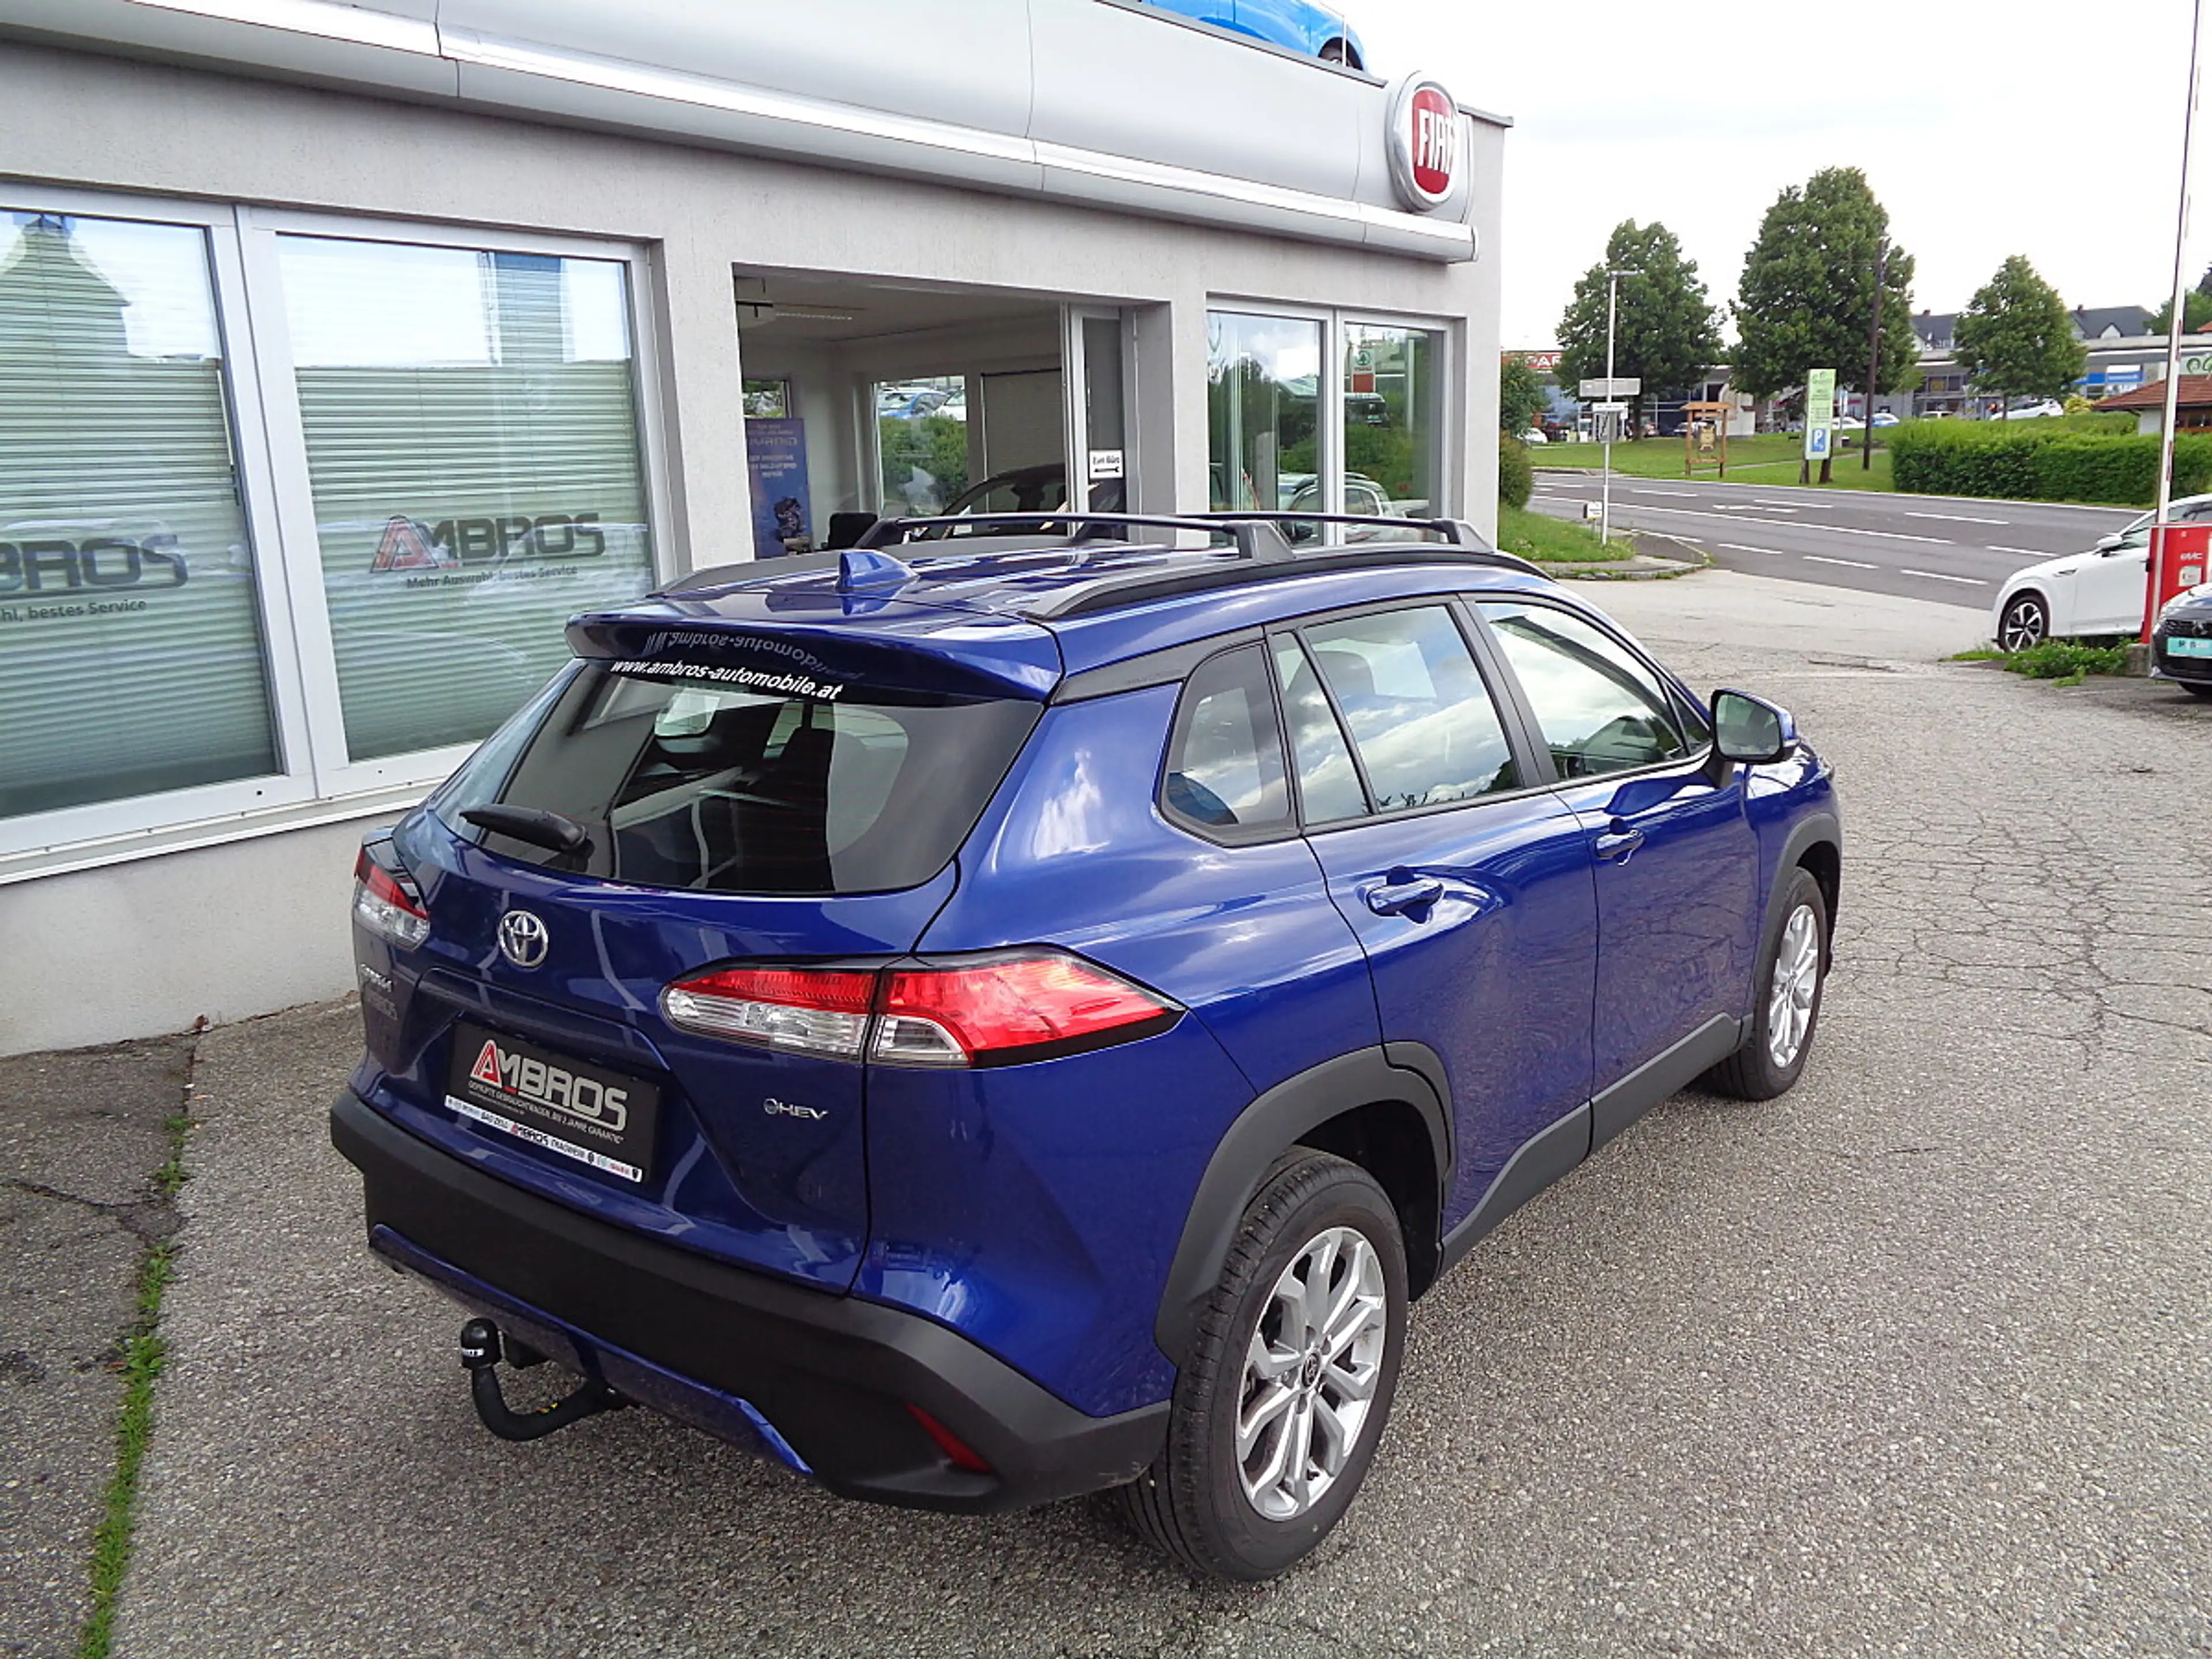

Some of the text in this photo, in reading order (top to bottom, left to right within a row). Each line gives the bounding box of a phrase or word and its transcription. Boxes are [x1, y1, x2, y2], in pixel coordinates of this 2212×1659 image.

[1416, 108, 1456, 175] FIAT
[370, 513, 606, 574] AMBROS
[406, 575, 440, 589] Mehr
[539, 564, 578, 577] Service
[28, 605, 84, 620] bestes
[89, 599, 147, 615] Service
[609, 659, 844, 700] www.ambros-automobile.at
[469, 1039, 628, 1131] AMBROS
